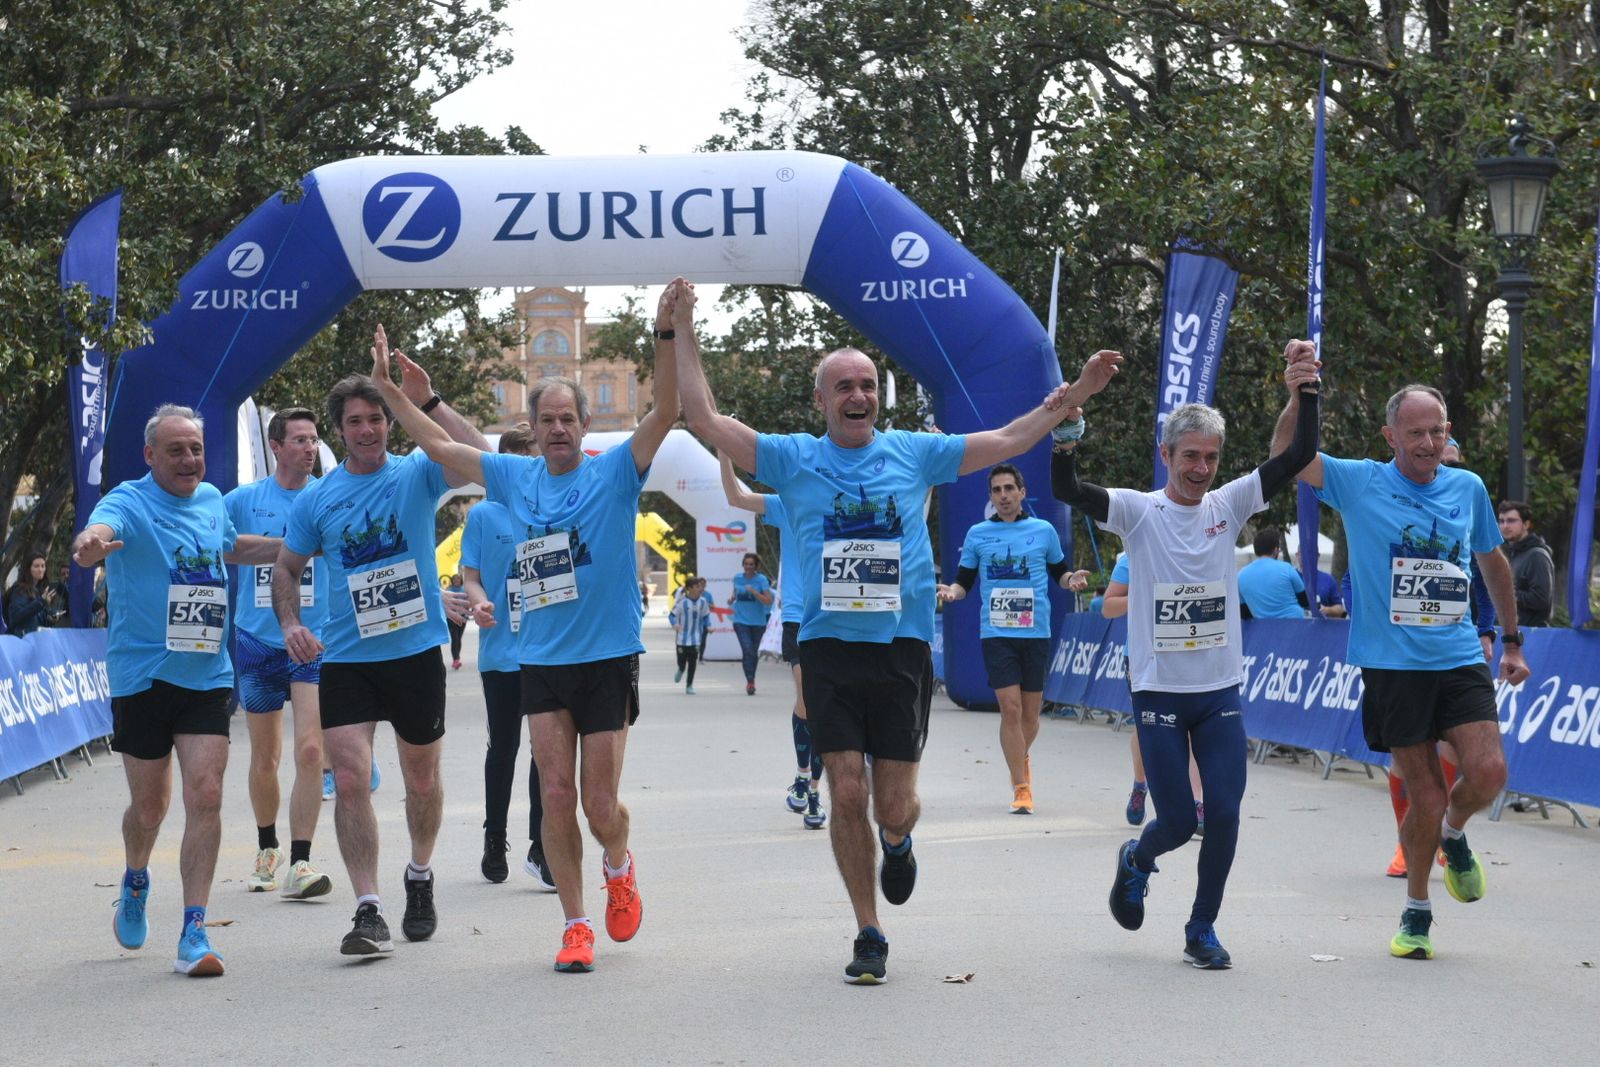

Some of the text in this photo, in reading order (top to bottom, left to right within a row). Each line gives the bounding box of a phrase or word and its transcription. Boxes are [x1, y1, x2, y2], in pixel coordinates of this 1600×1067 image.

[492, 186, 768, 242] ZURICH
[190, 288, 299, 311] ZURICH
[861, 278, 968, 303] ZURICH
[1213, 291, 1229, 319] body
[1207, 320, 1221, 352] sound
[1163, 311, 1200, 412] asics
[1201, 355, 1215, 382] mind,
[528, 540, 545, 552] asics
[853, 543, 875, 552] asics
[376, 568, 395, 579] asics
[519, 556, 538, 581] 5K
[827, 558, 863, 579] 5K
[1423, 562, 1444, 571] asics
[197, 589, 214, 597] asics
[539, 581, 545, 592] 2
[858, 585, 864, 596] 1
[1184, 586, 1205, 594] asics
[1396, 575, 1432, 596] 5K
[358, 584, 389, 609] 5K
[992, 598, 1012, 610] 5K
[172, 602, 207, 622] 5K
[389, 607, 397, 617] 5
[1159, 601, 1194, 621] 5K
[1420, 602, 1441, 612] 325
[201, 628, 207, 638] 4
[1190, 625, 1197, 636] 3
[1071, 641, 1101, 676] asic
[1265, 656, 1309, 703] asics
